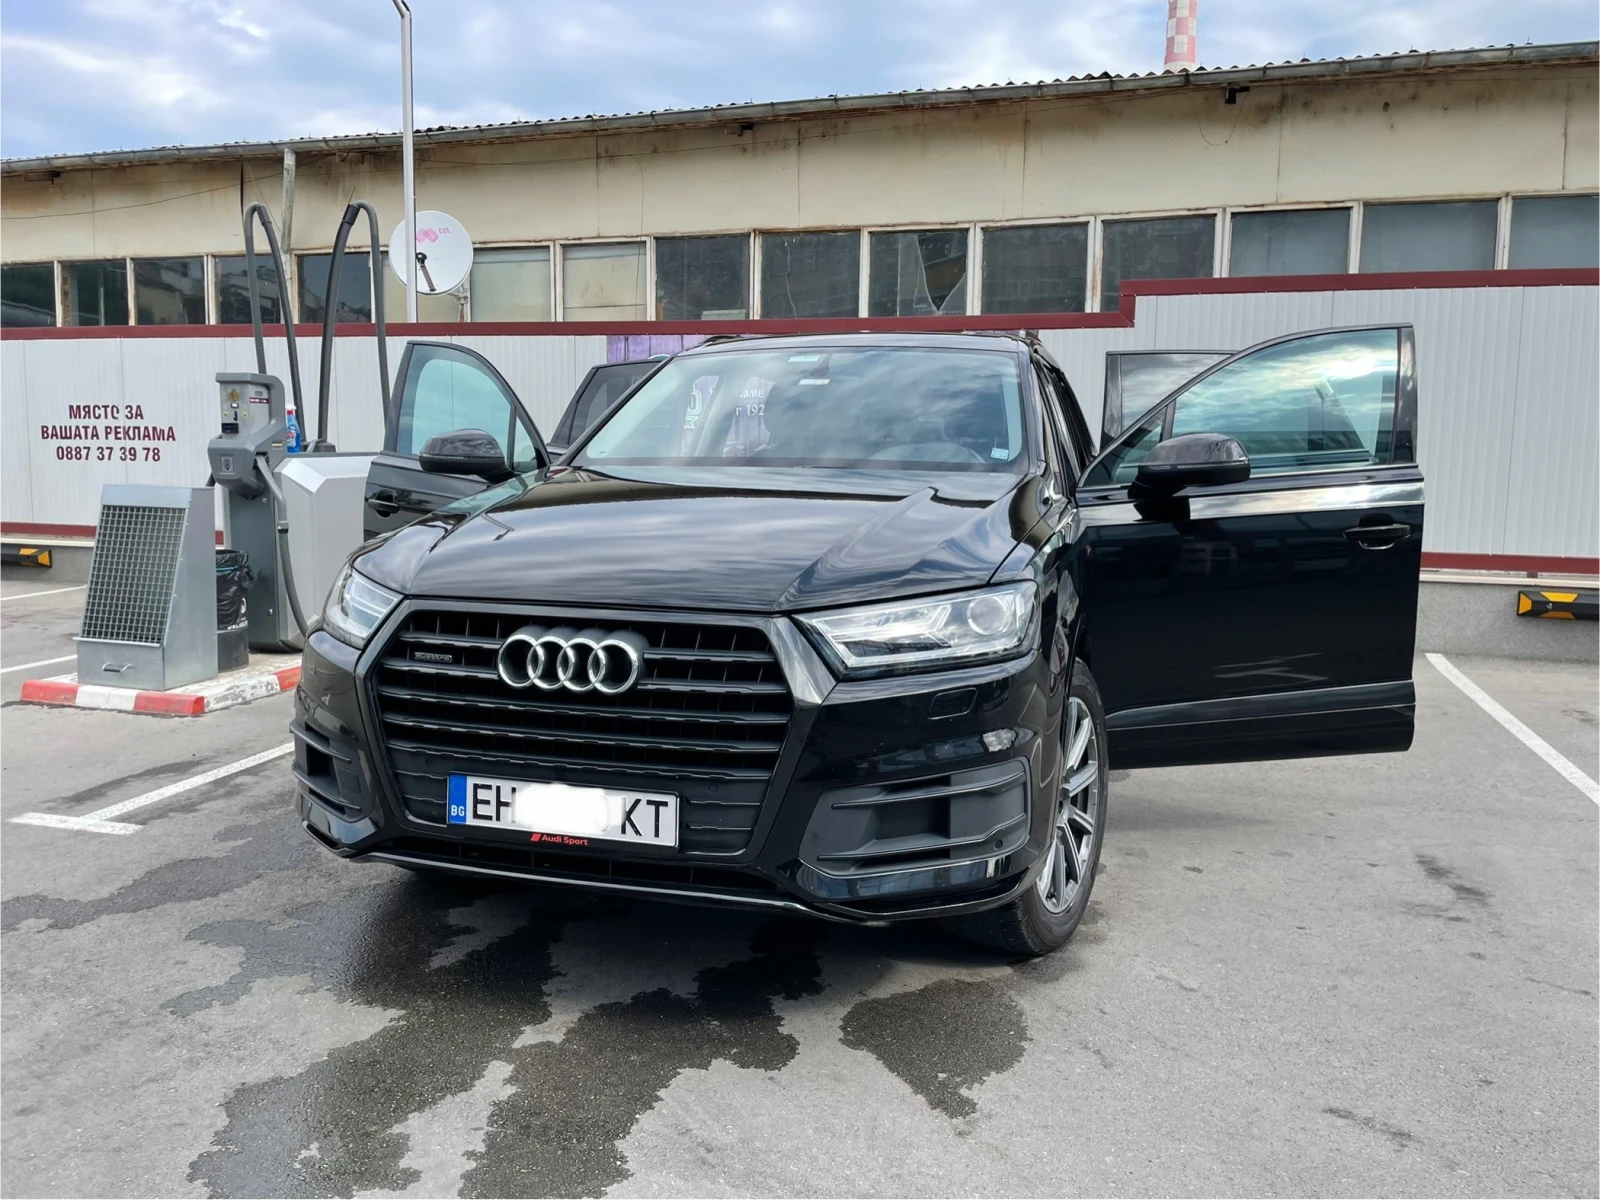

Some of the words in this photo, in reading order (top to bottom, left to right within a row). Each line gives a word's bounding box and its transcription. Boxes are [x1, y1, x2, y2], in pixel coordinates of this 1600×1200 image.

[68, 404, 120, 420] МЯСТО
[125, 404, 144, 420] ЗА
[41, 425, 100, 440] ВАШАТА
[104, 425, 176, 441] РЕКЛАМА
[56, 445, 91, 461] 0887
[96, 446, 114, 461] 37
[119, 446, 137, 462] 39
[142, 447, 161, 462] 78
[451, 805, 465, 816] BG
[541, 834, 562, 843] Audi
[563, 836, 588, 846] Sport
